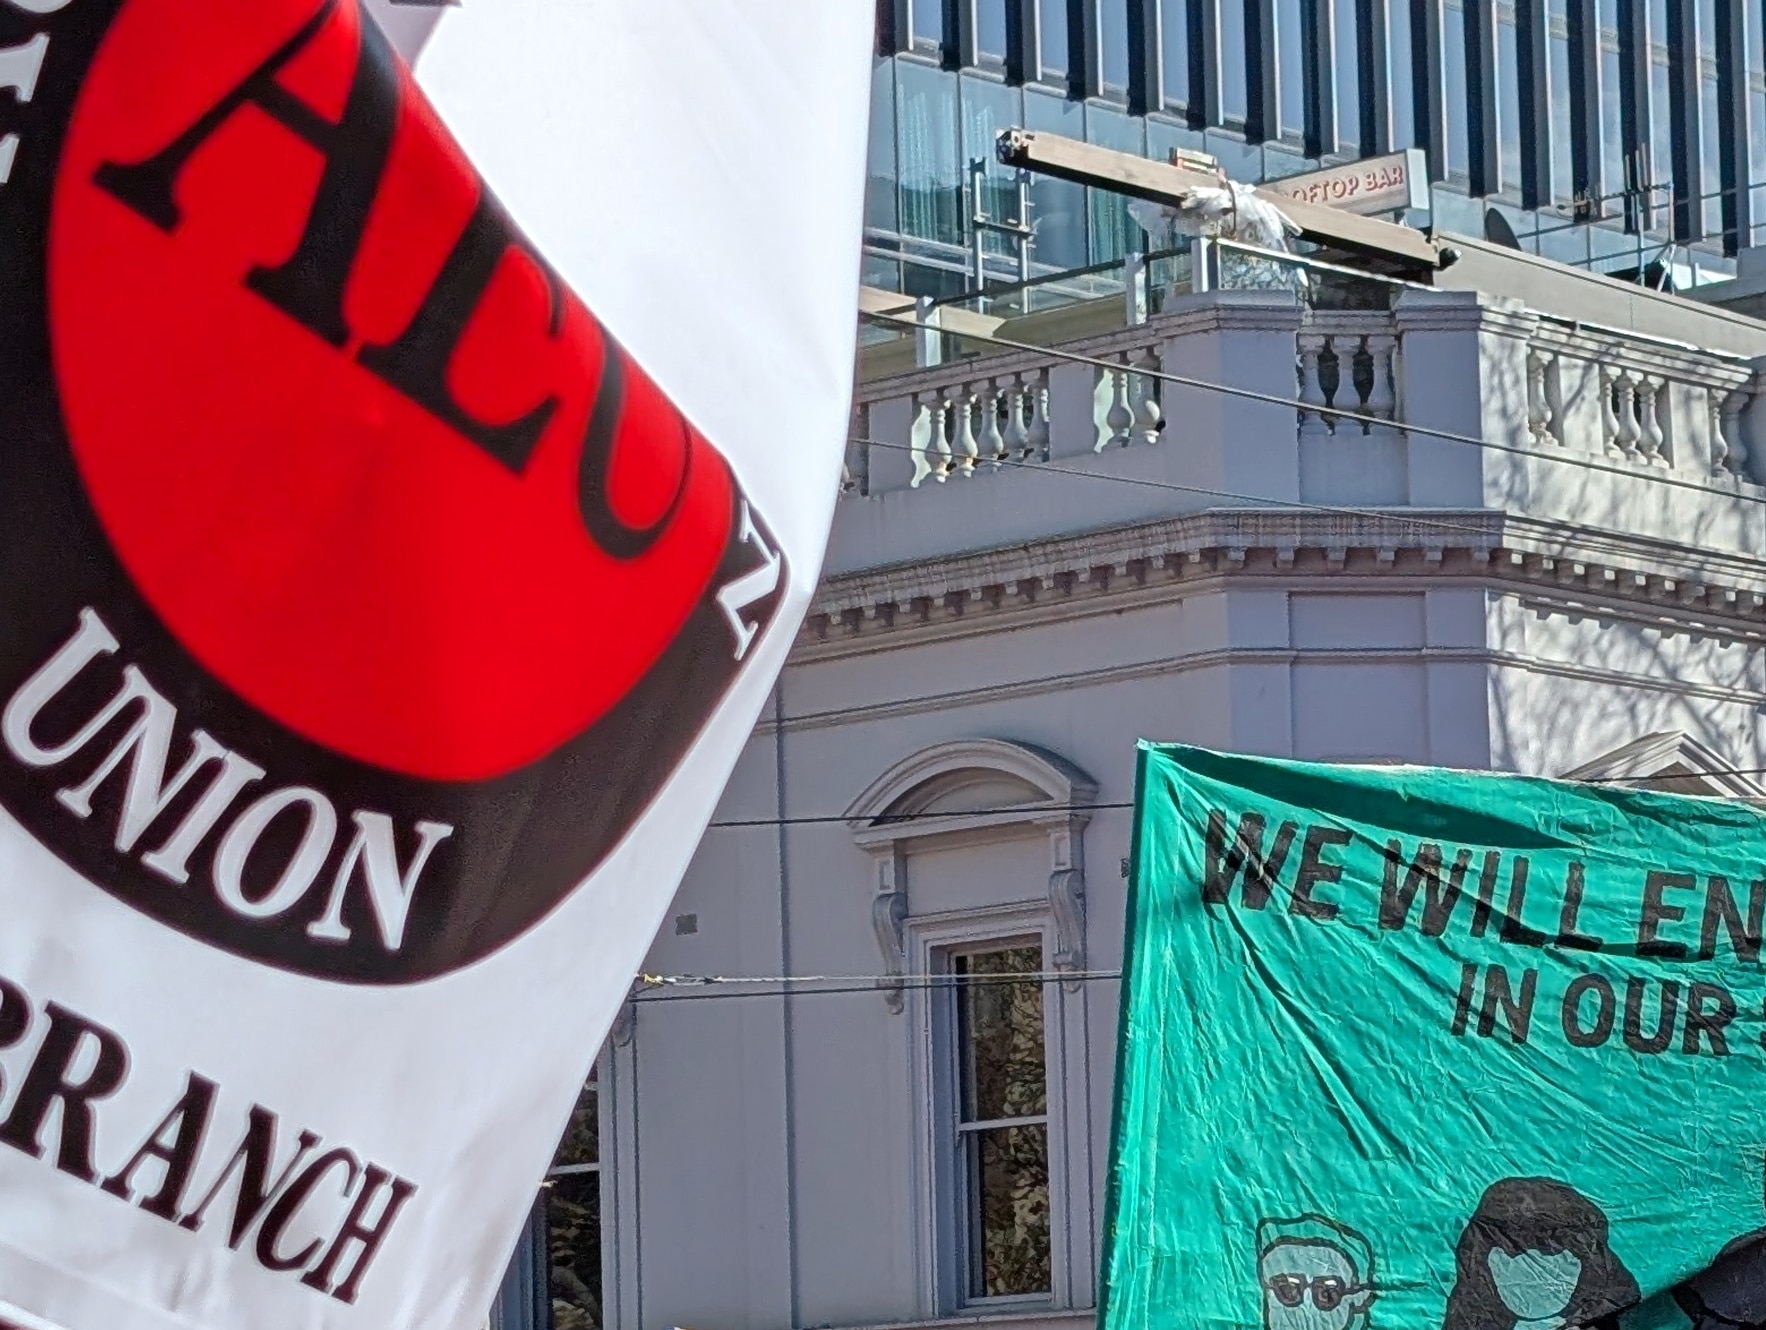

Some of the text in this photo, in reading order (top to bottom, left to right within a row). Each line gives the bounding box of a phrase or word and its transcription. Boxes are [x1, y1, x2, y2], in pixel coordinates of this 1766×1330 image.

[1365, 166, 1403, 192] BAR
[2, 606, 454, 952] UNION
[1201, 808, 1350, 919] WE
[1379, 836, 1604, 954] WILL
[1450, 962, 1540, 1044] IN
[1560, 970, 1738, 1058] OUR
